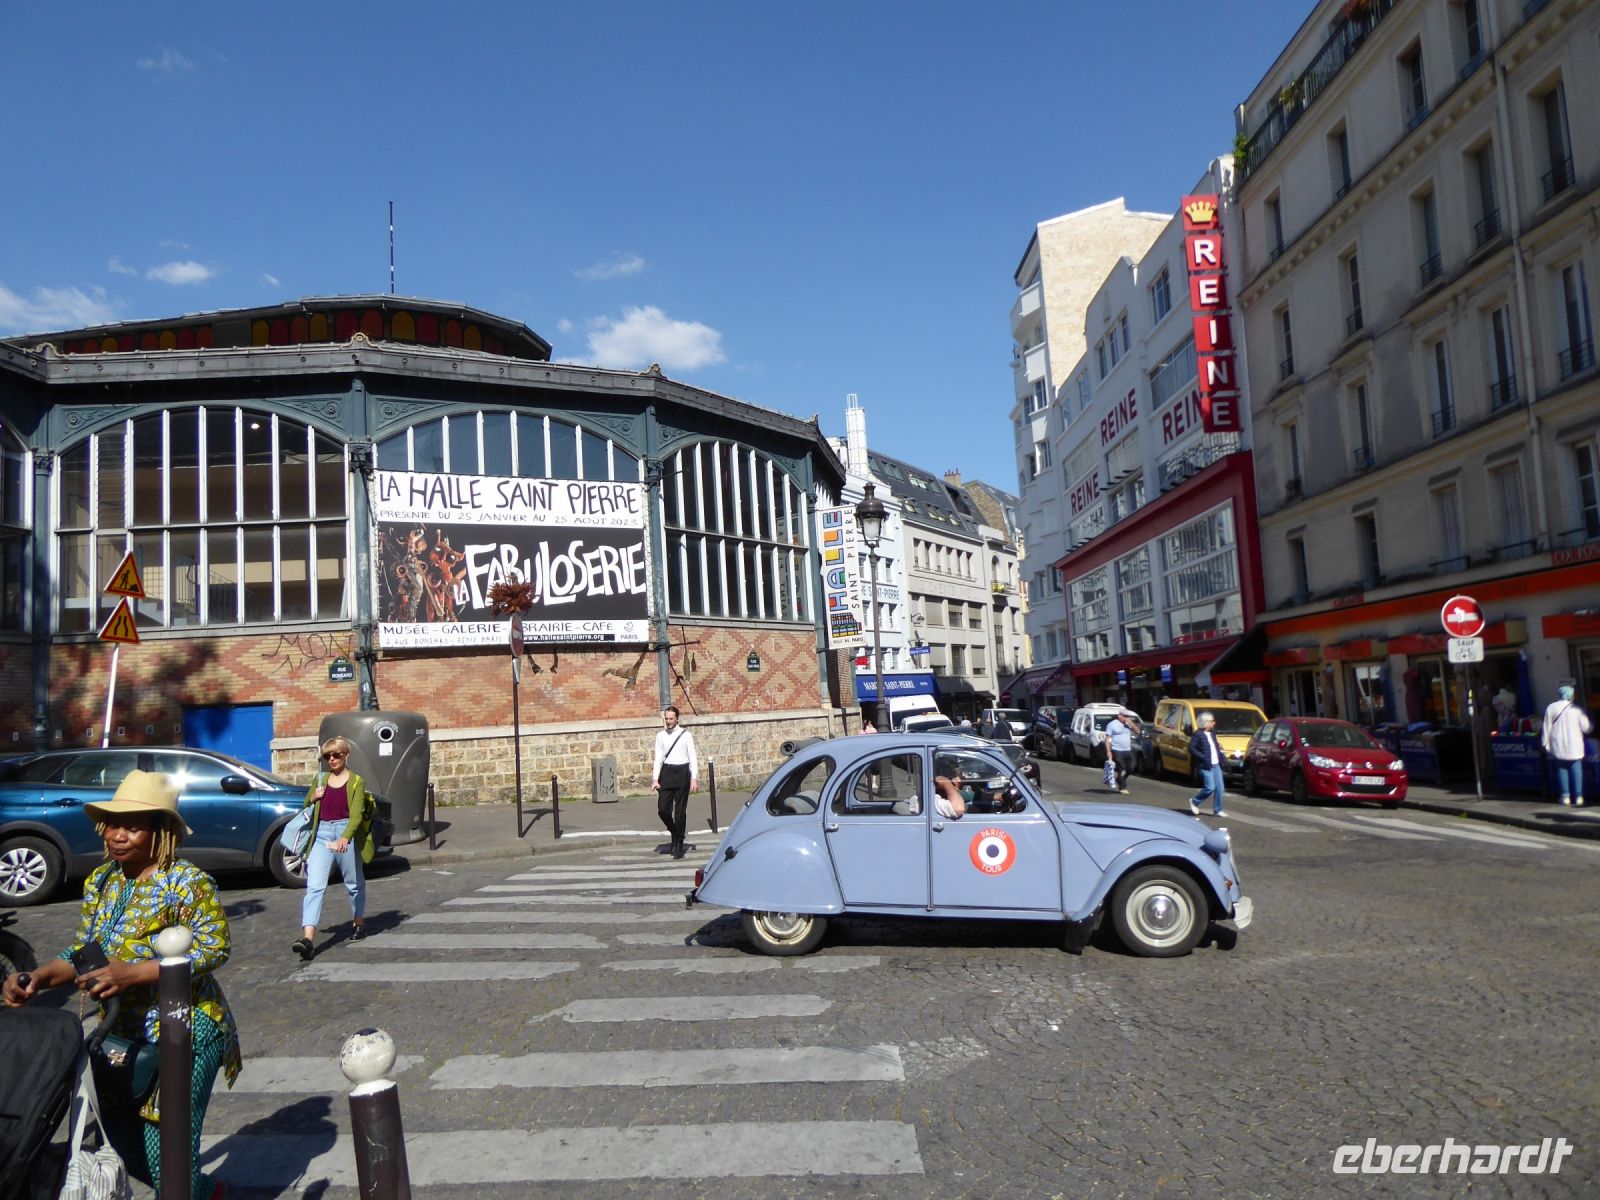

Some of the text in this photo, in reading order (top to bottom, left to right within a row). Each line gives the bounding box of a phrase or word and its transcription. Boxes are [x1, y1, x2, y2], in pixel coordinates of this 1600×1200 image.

[1193, 239, 1232, 426] REINE
[1101, 388, 1138, 447] REINE
[1162, 389, 1202, 445] REIN
[380, 474, 639, 515] LA HALLE SAINT PIERRE
[438, 511, 451, 520] DU
[458, 512, 472, 520] 25
[477, 512, 528, 522] JANVIER
[533, 513, 546, 522] AU
[1070, 471, 1100, 516] REINE
[823, 511, 848, 611] HALLE
[844, 509, 860, 609] SAINT PIERRE
[453, 579, 470, 605] LA
[383, 623, 430, 635] MUSÉE
[441, 623, 502, 634] GALERIE
